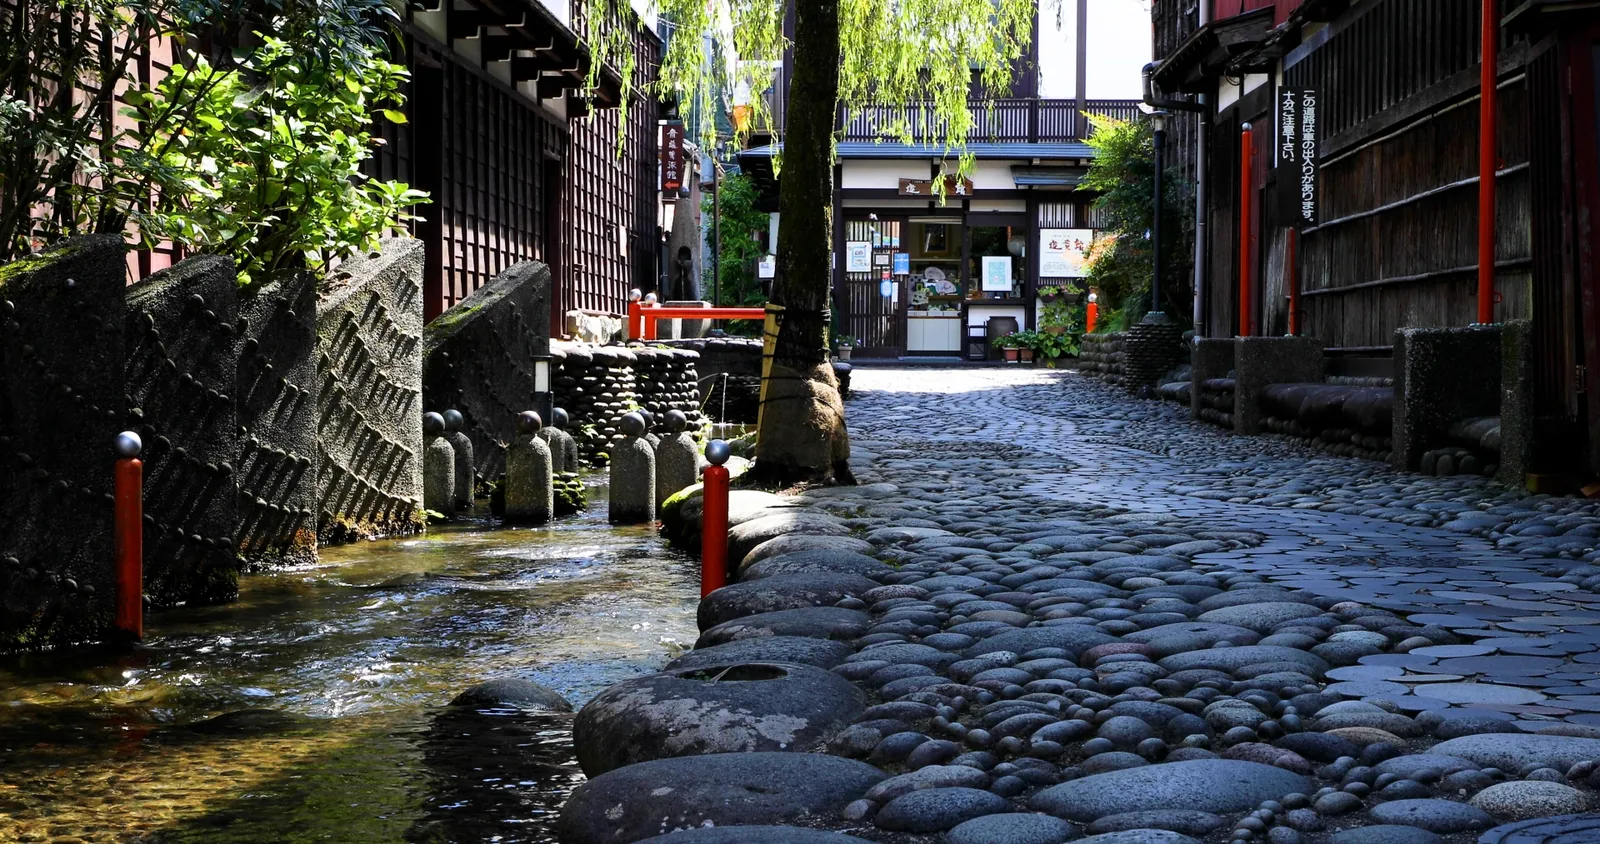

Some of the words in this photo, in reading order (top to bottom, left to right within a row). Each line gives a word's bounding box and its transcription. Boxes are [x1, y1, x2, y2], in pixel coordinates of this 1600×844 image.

[1282, 90, 1295, 162] 十分ご注意下さい。
[1301, 90, 1315, 222] この道路は車の出入りがあります。
